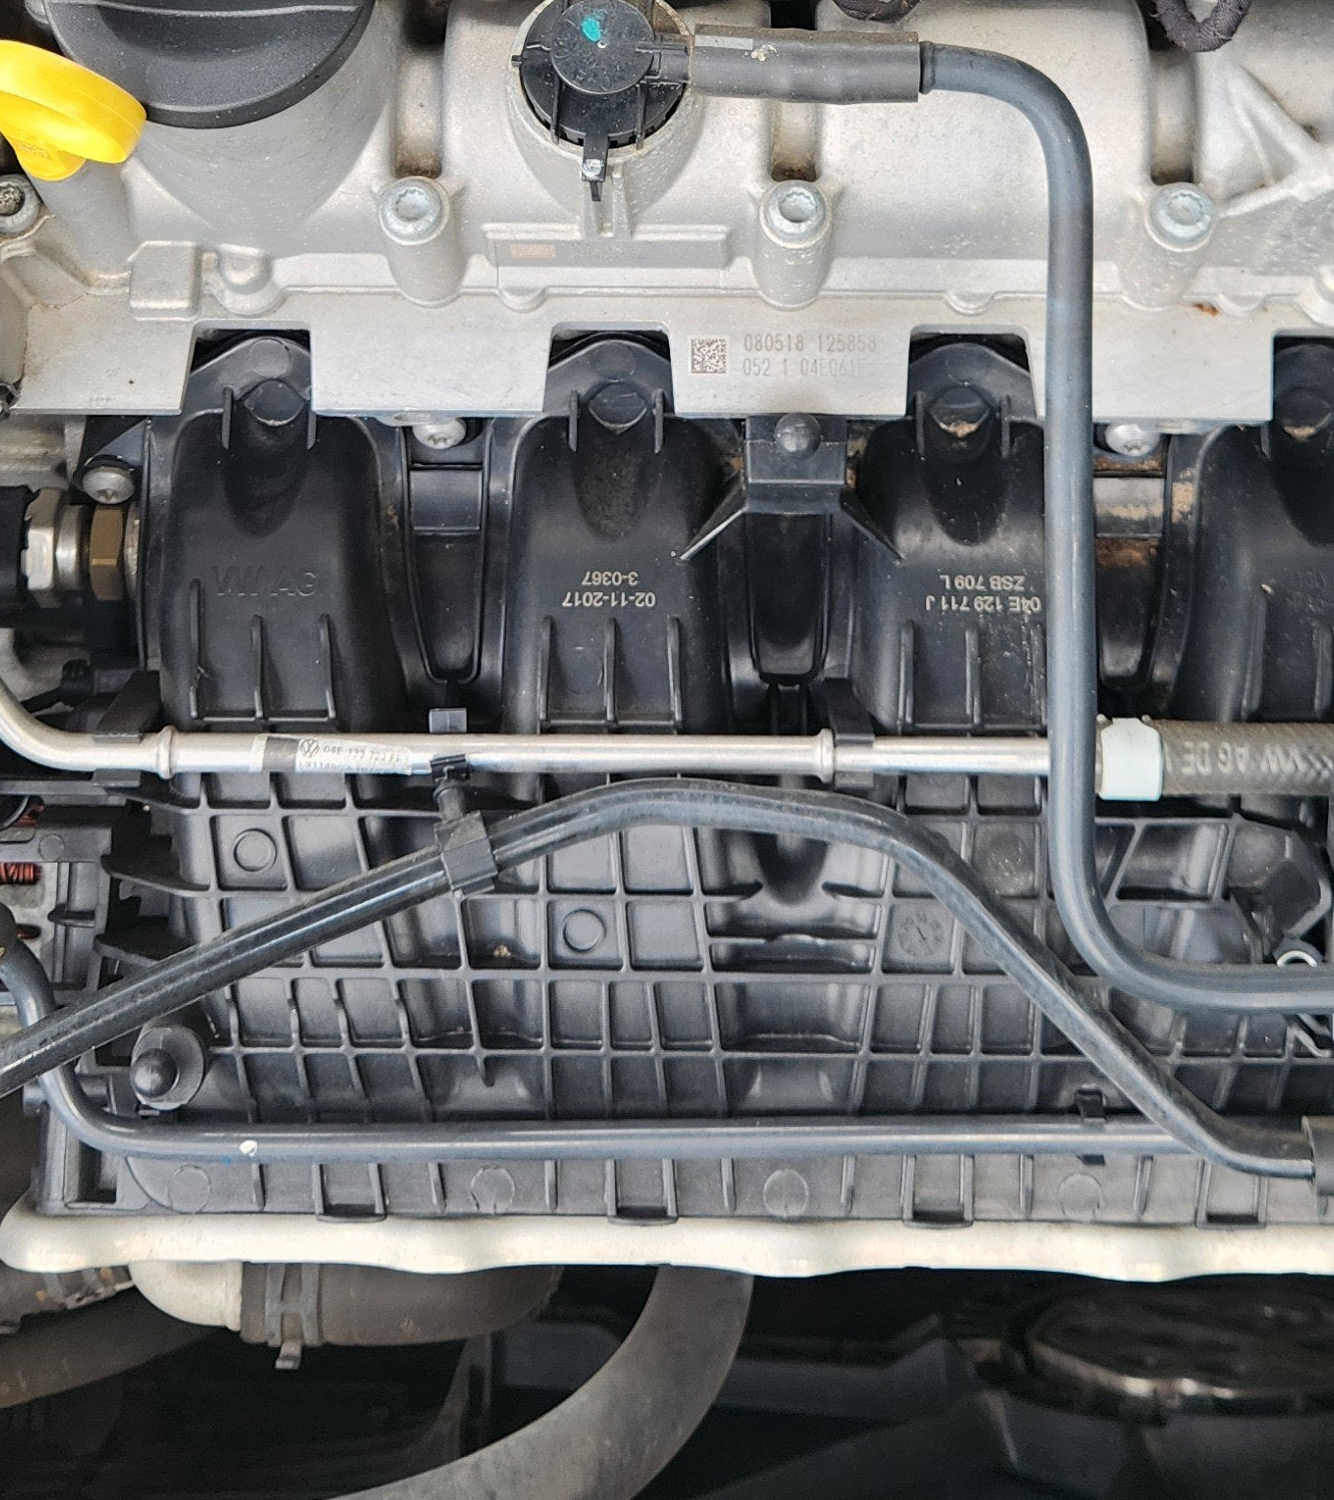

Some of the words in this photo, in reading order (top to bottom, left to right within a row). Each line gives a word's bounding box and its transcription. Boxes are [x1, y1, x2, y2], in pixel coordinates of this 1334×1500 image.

[743, 333, 804, 351] 080518
[818, 333, 876, 352] 125858
[581, 570, 638, 585] 3-0367
[939, 575, 950, 589] L
[954, 575, 984, 589] 709
[989, 575, 1024, 590] ZSB
[561, 591, 655, 606] 02-11-2017
[925, 595, 935, 609] J
[940, 595, 969, 610] 711
[973, 595, 1002, 610] 129
[1008, 595, 1041, 611] 04E
[1180, 740, 1212, 775] DE
[1216, 741, 1250, 774] AG
[1259, 742, 1307, 776] VW
